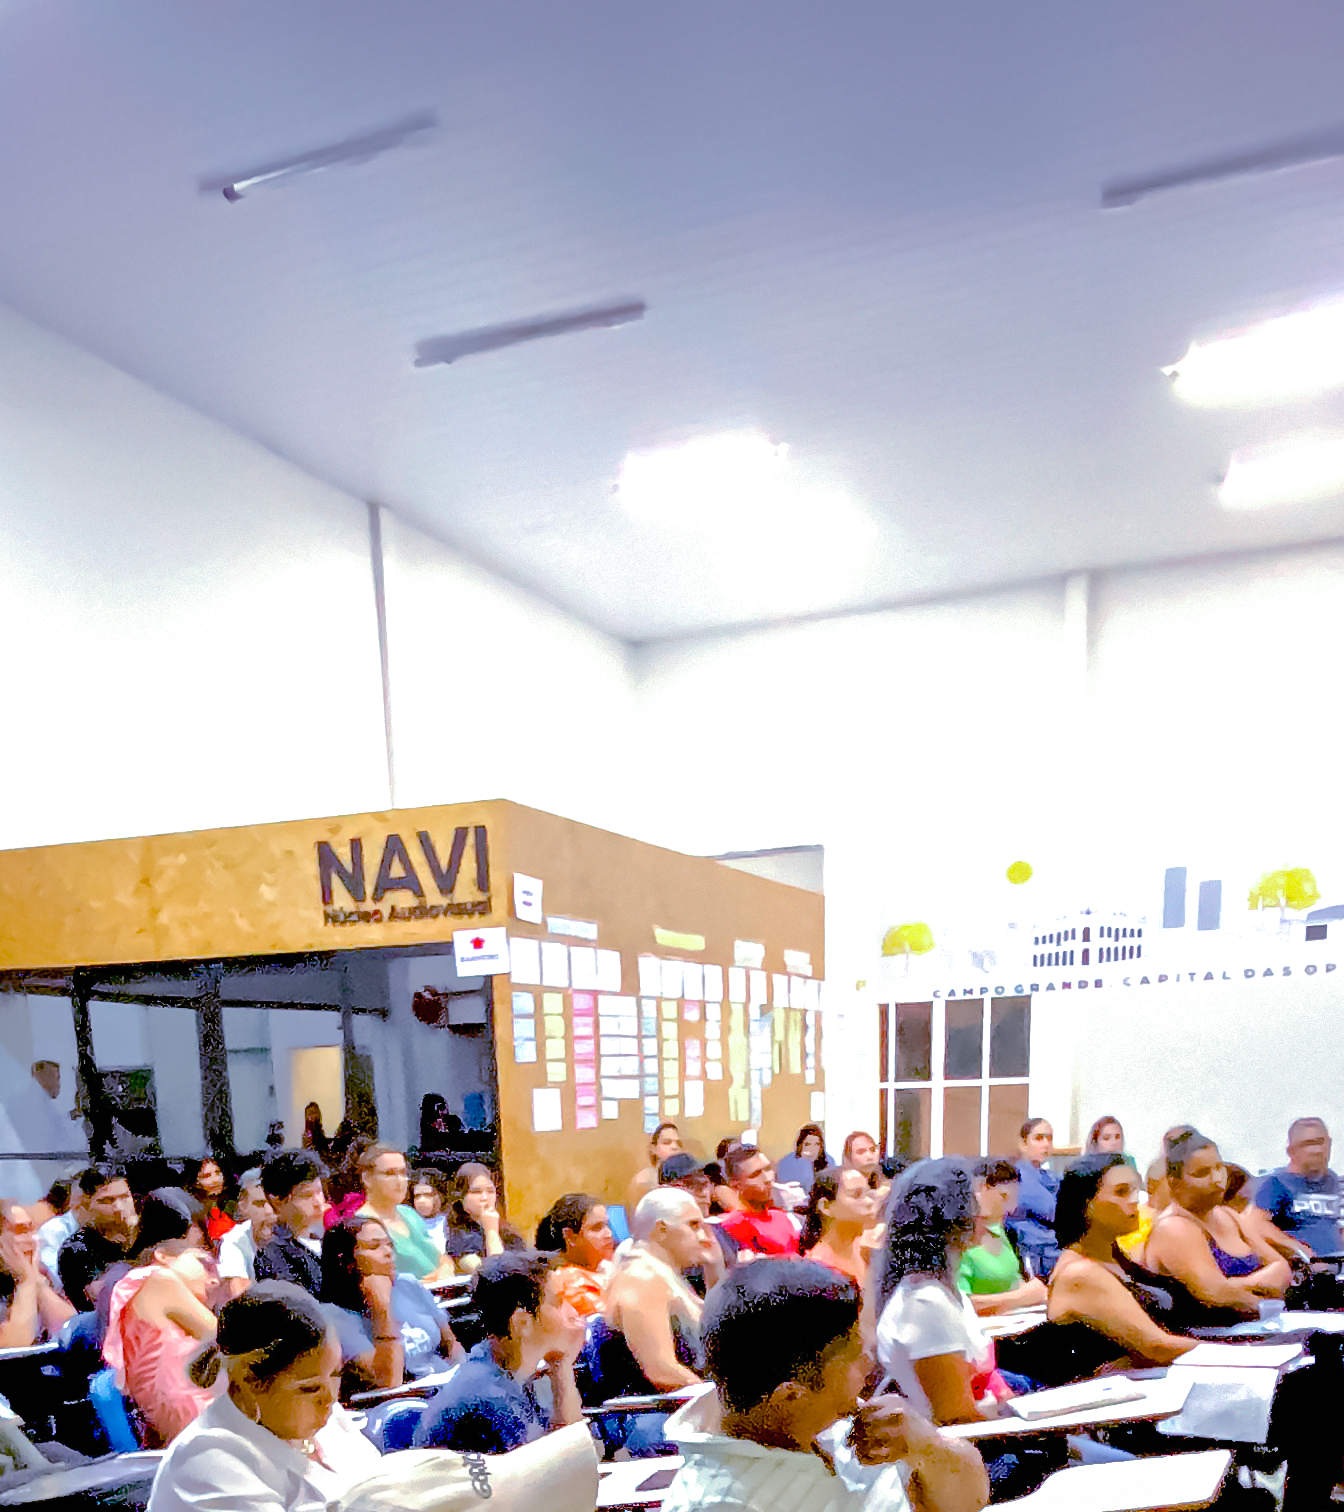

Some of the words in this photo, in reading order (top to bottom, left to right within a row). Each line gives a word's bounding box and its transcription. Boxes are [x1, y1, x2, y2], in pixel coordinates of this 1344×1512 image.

[317, 825, 490, 903] NAVI
[932, 985, 1006, 999] CAMPO
[1122, 971, 1233, 987] CAPITAL
[1243, 965, 1294, 980] DAS
